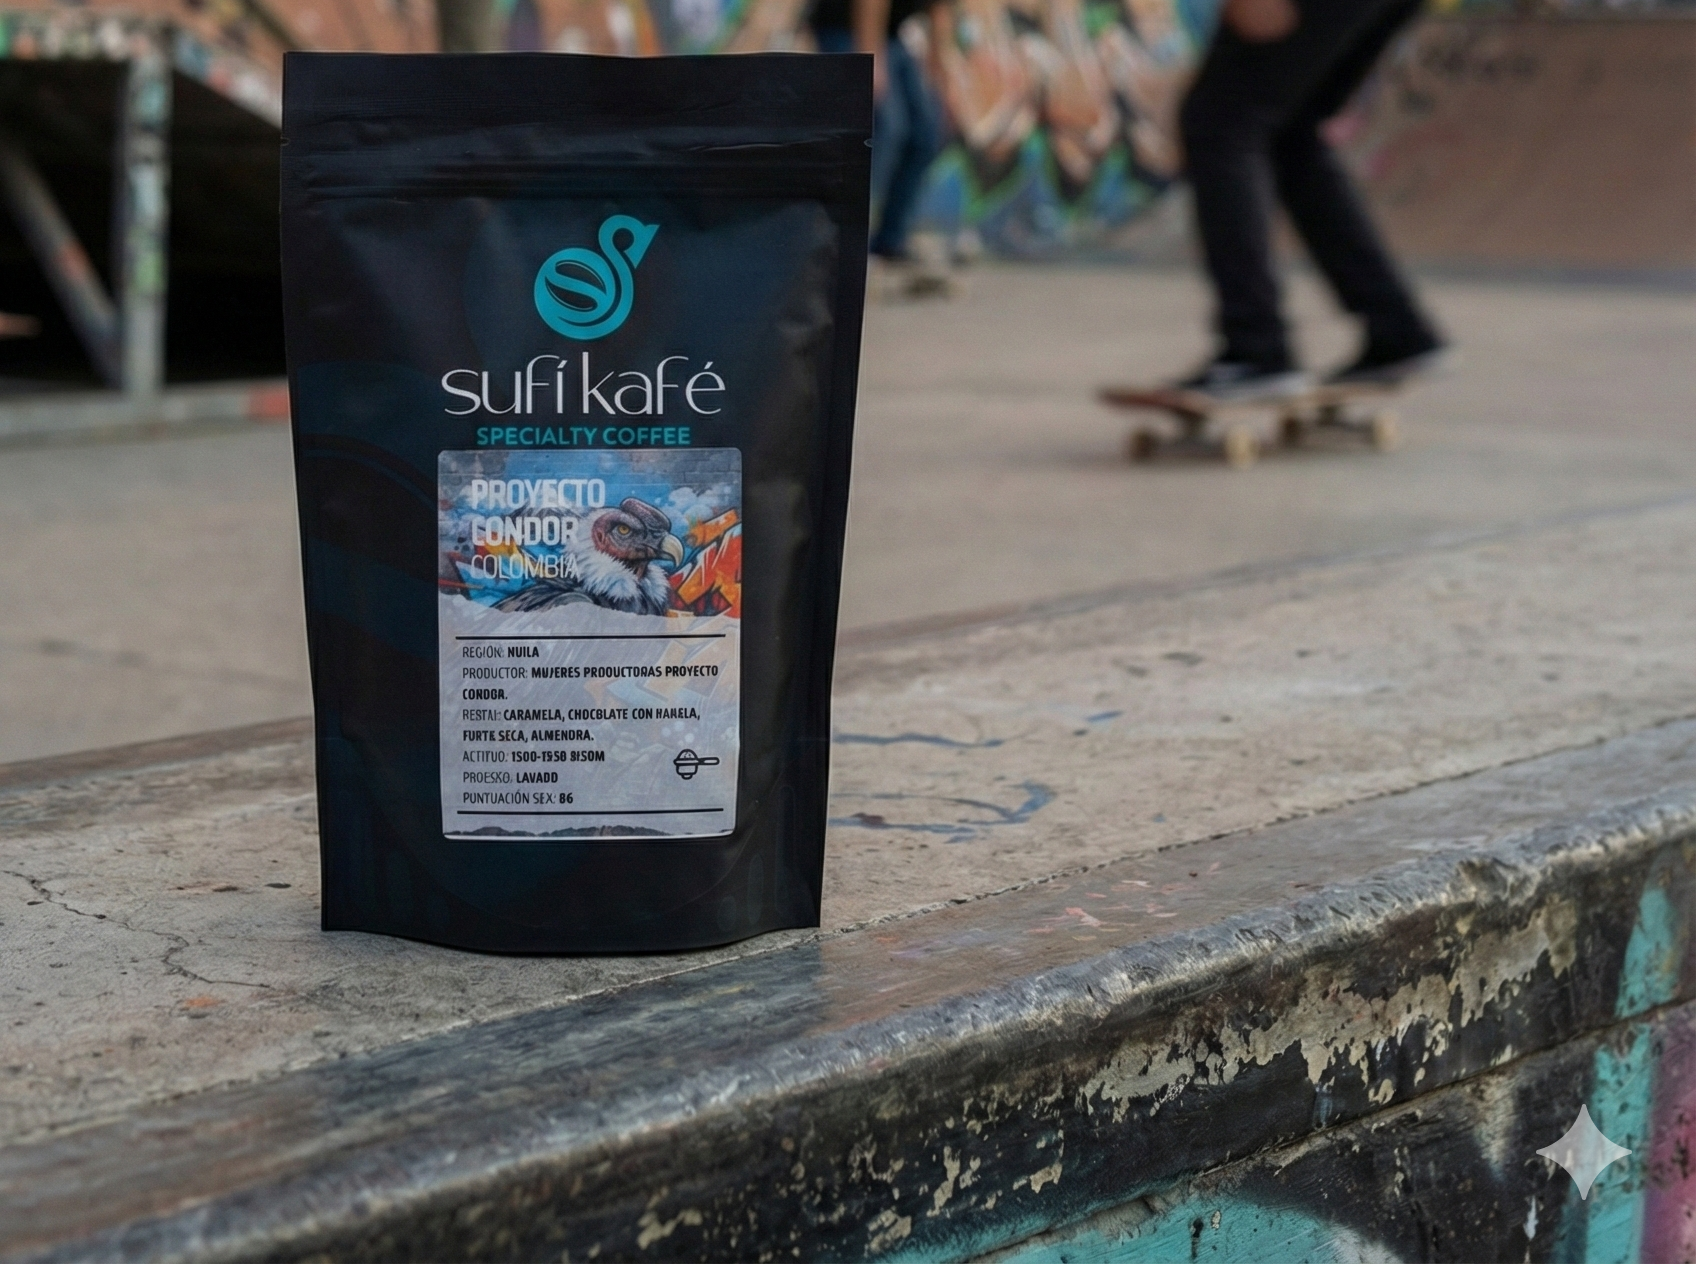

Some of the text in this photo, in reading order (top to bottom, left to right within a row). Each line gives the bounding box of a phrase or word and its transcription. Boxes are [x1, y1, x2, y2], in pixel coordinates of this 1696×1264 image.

[477, 427, 691, 445] SPECIALTY COFFEE
[471, 479, 606, 508] PROYECTO
[471, 516, 579, 546] CONDOR
[470, 554, 580, 580] COLOMBIA
[463, 667, 527, 679] PRODUCTOR:
[532, 667, 580, 678] MUJERES
[665, 665, 718, 677] PROYECTO
[504, 709, 565, 722] CARAMELA,
[632, 708, 652, 719] CON
[498, 730, 528, 743] SECA,
[559, 792, 573, 804] 86
